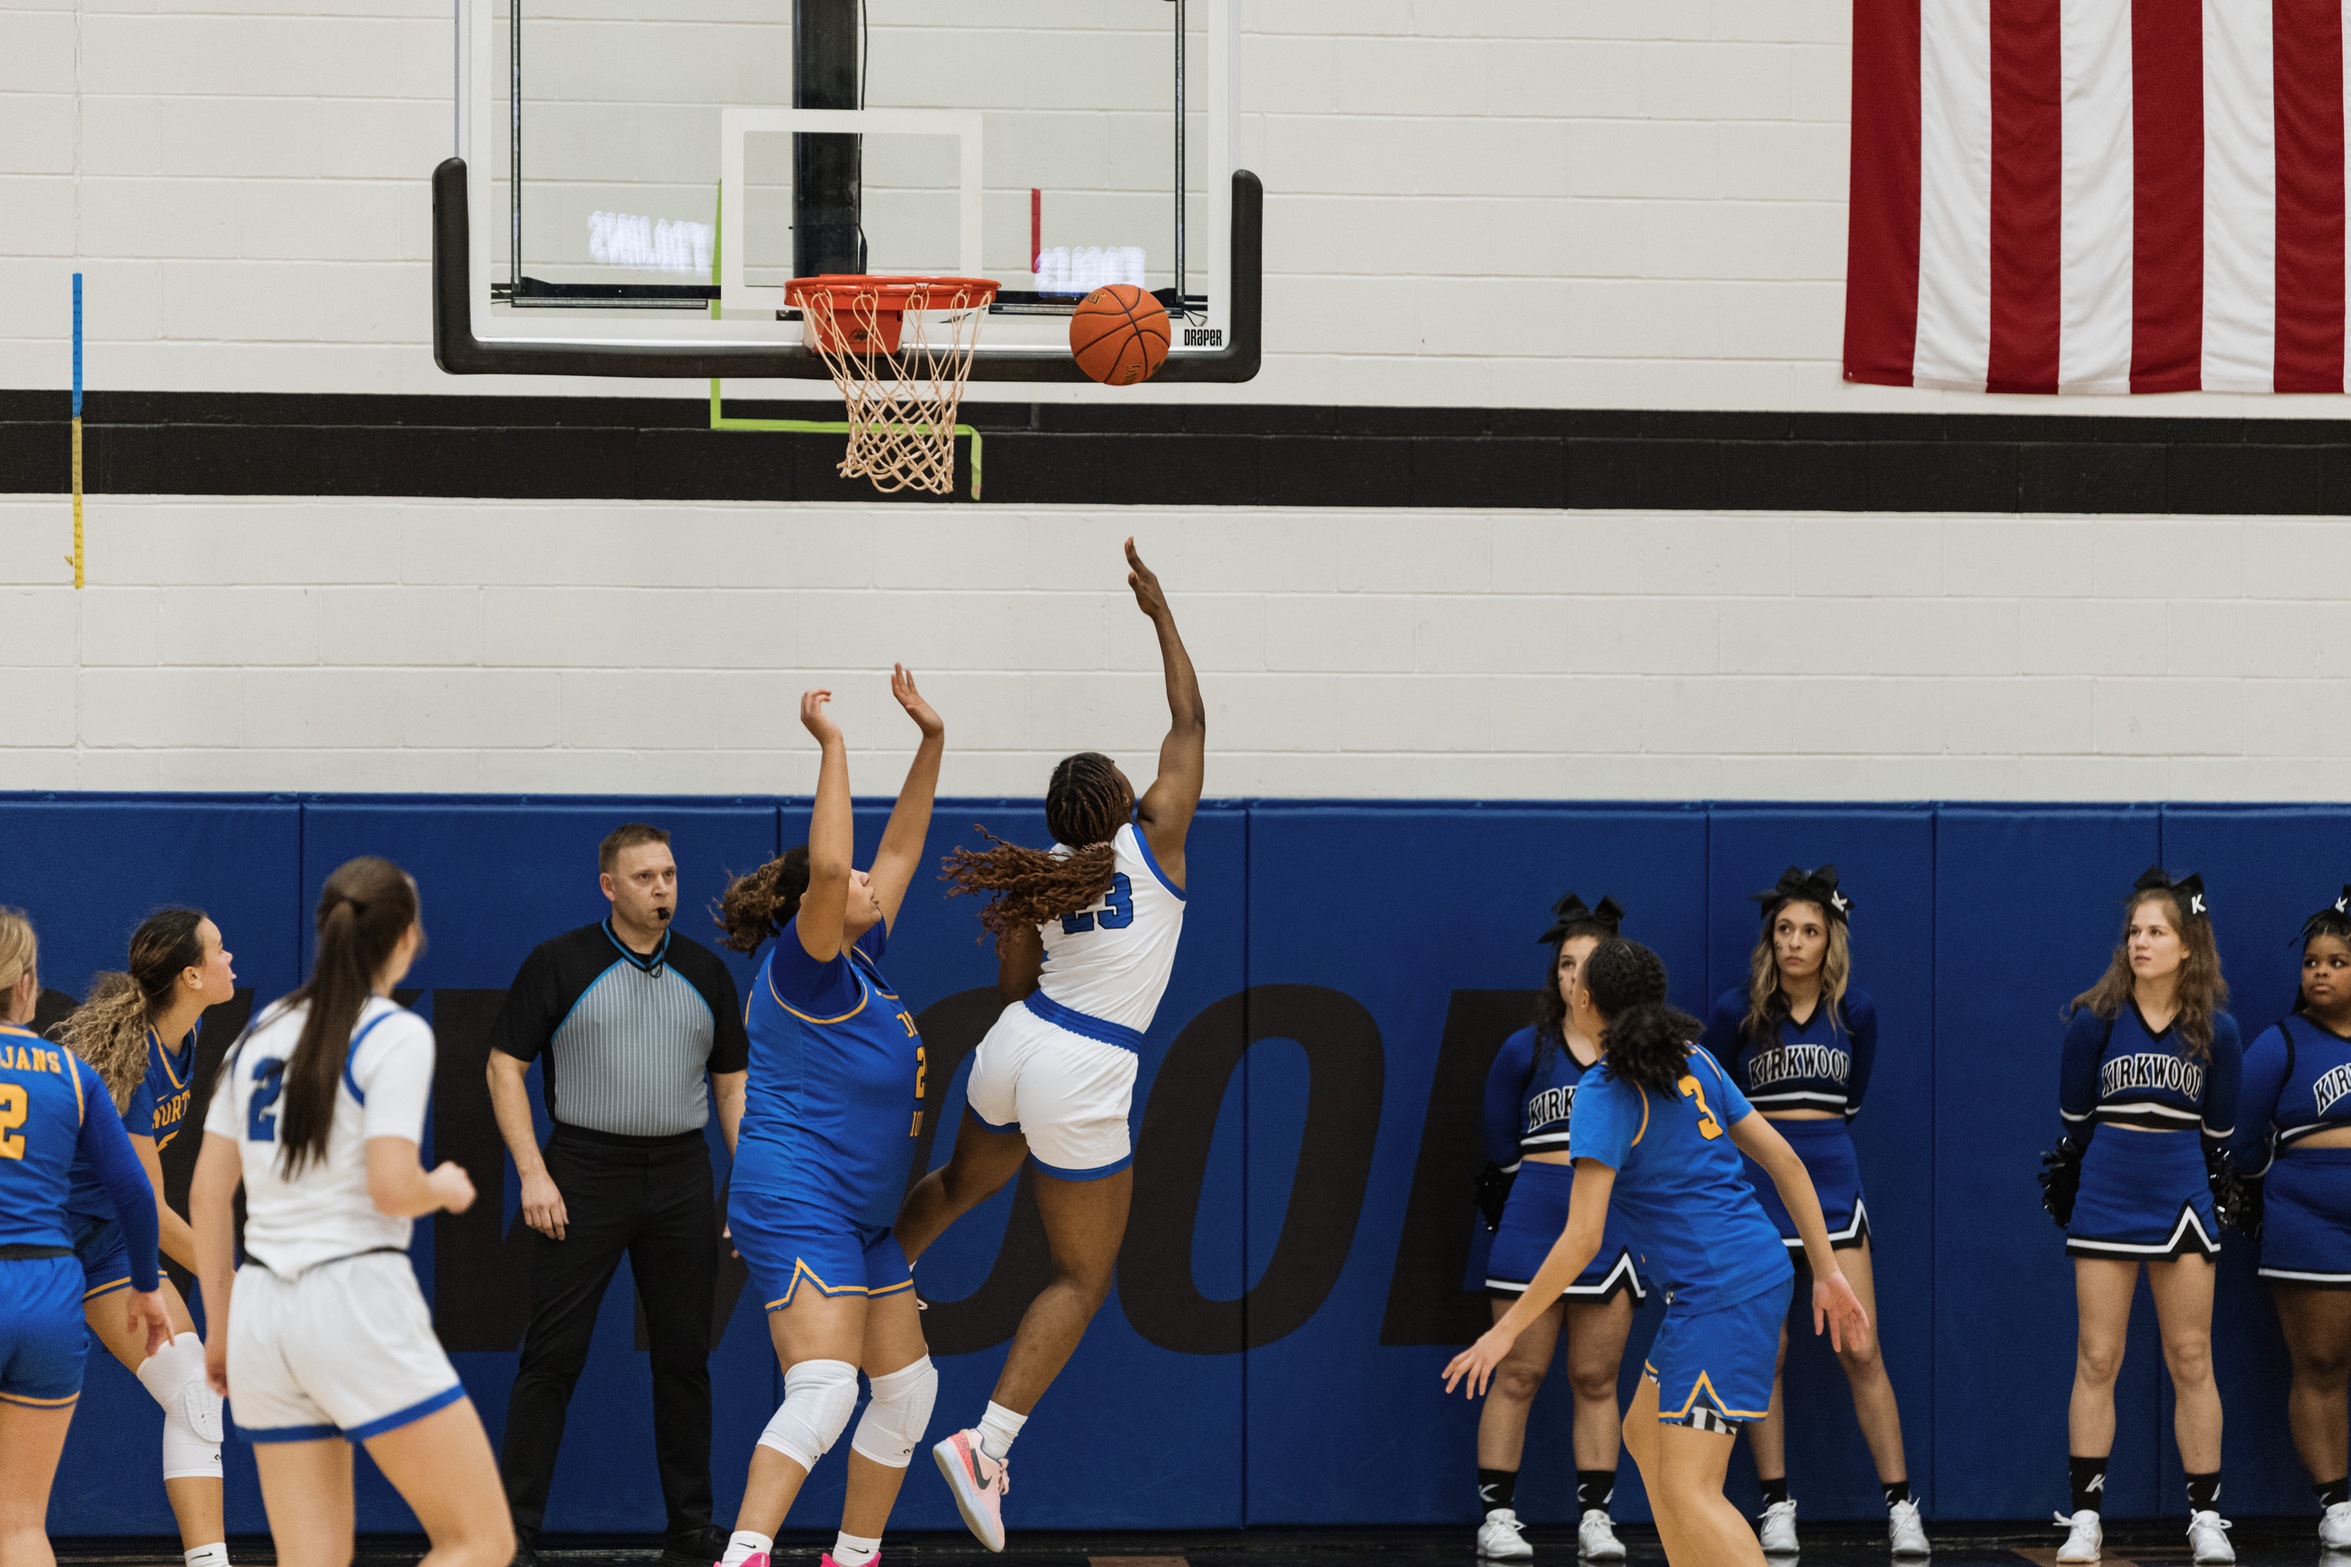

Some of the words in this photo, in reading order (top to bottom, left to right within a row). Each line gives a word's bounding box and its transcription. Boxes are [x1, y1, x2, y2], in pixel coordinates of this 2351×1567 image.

[1831, 889, 1848, 913] K
[2191, 893, 2207, 915] K
[2335, 896, 2348, 913] K
[247, 1056, 285, 1142] 2
[1677, 1074, 1724, 1141] 3
[2312, 1062, 2351, 1117] KIR
